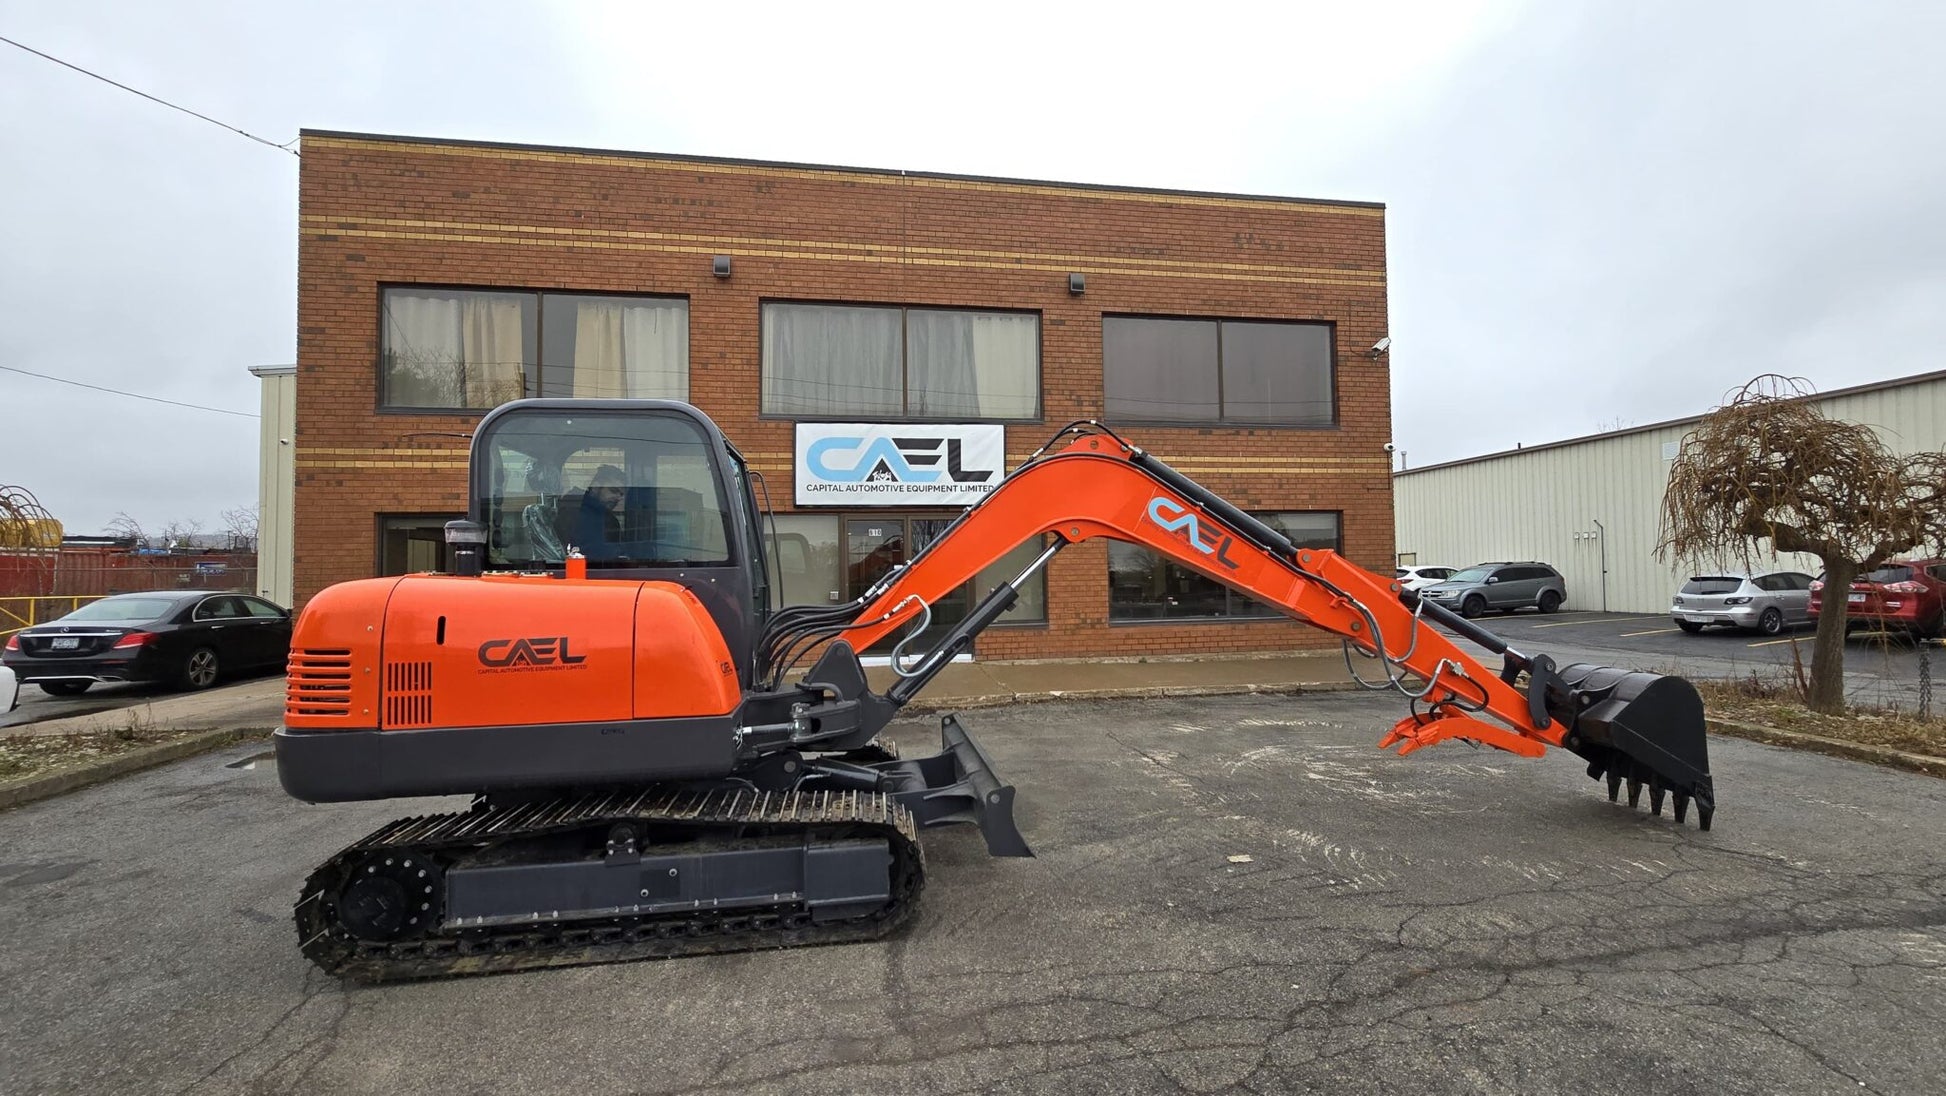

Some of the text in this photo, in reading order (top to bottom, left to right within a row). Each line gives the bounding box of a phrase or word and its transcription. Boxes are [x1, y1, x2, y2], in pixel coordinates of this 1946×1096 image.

[806, 436, 994, 482] CAEL
[806, 484, 994, 493] CAPITAL AUTOMOTIVE EQUIPMENT LIMITED
[1148, 497, 1240, 570] CAEL
[478, 637, 586, 667] CAEL
